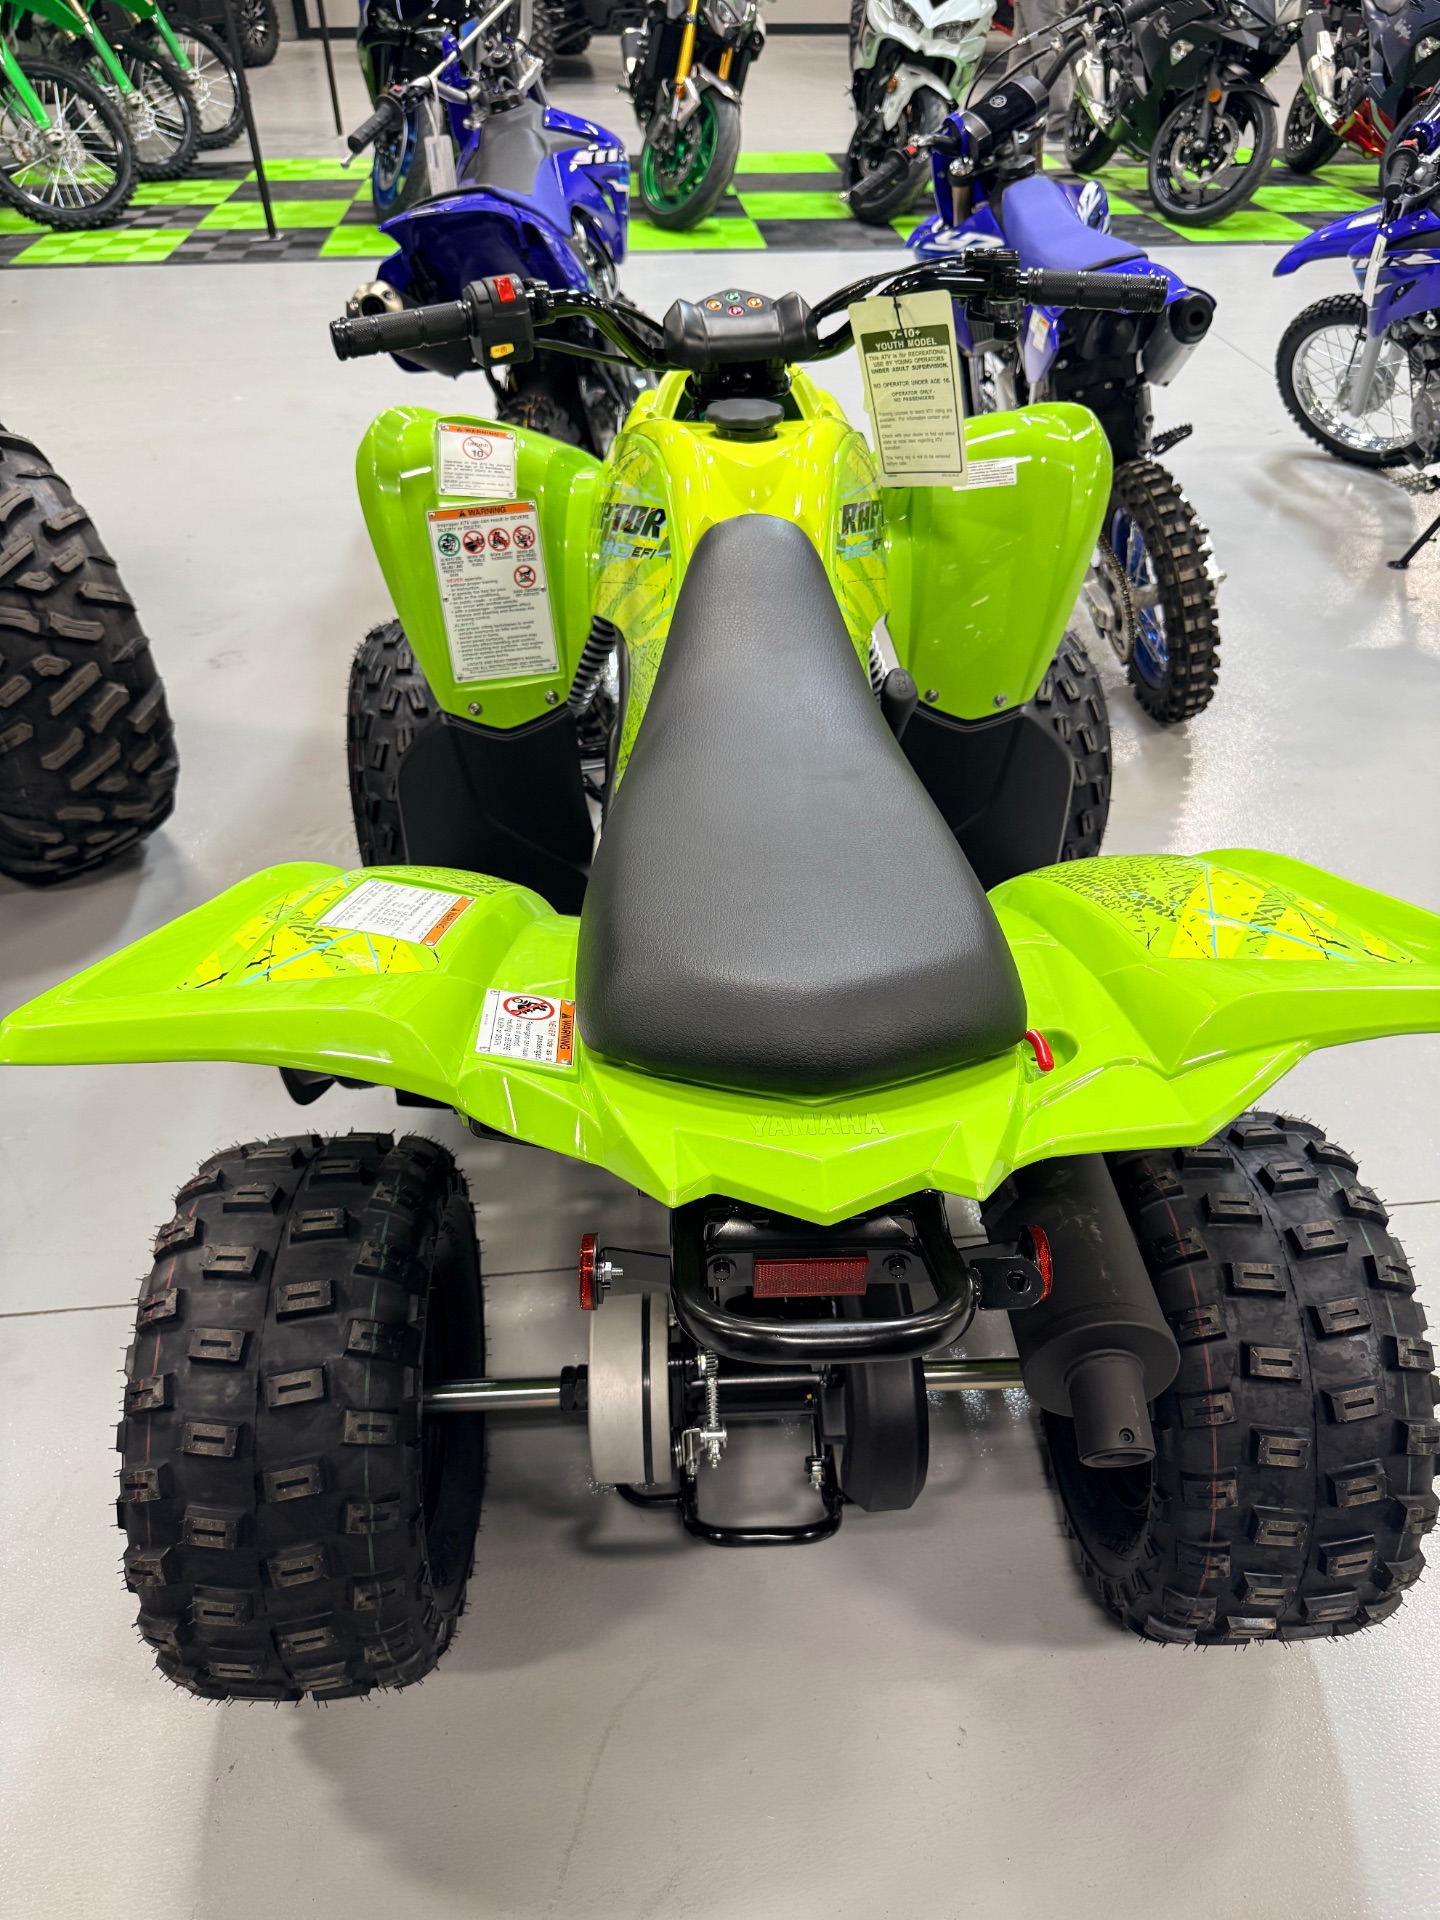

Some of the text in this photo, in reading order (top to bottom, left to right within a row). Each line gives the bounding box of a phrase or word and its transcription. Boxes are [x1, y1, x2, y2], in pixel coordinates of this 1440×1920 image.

[889, 328, 921, 340] Y-10+
[875, 337, 937, 351] YOUTH MODEL
[908, 348, 947, 357] RECREATIONAL
[912, 363, 948, 371] SUPERVISION.
[468, 506, 507, 516] WARNING
[841, 500, 884, 538] RAP
[600, 503, 667, 539] PTOR
[631, 546, 656, 560] EFI
[845, 540, 874, 562] 110
[548, 1020, 556, 1036] NEVER
[560, 1020, 572, 1050] WARNING
[534, 1035, 543, 1060] passenger.
[747, 1112, 886, 1137] YAMAHA
